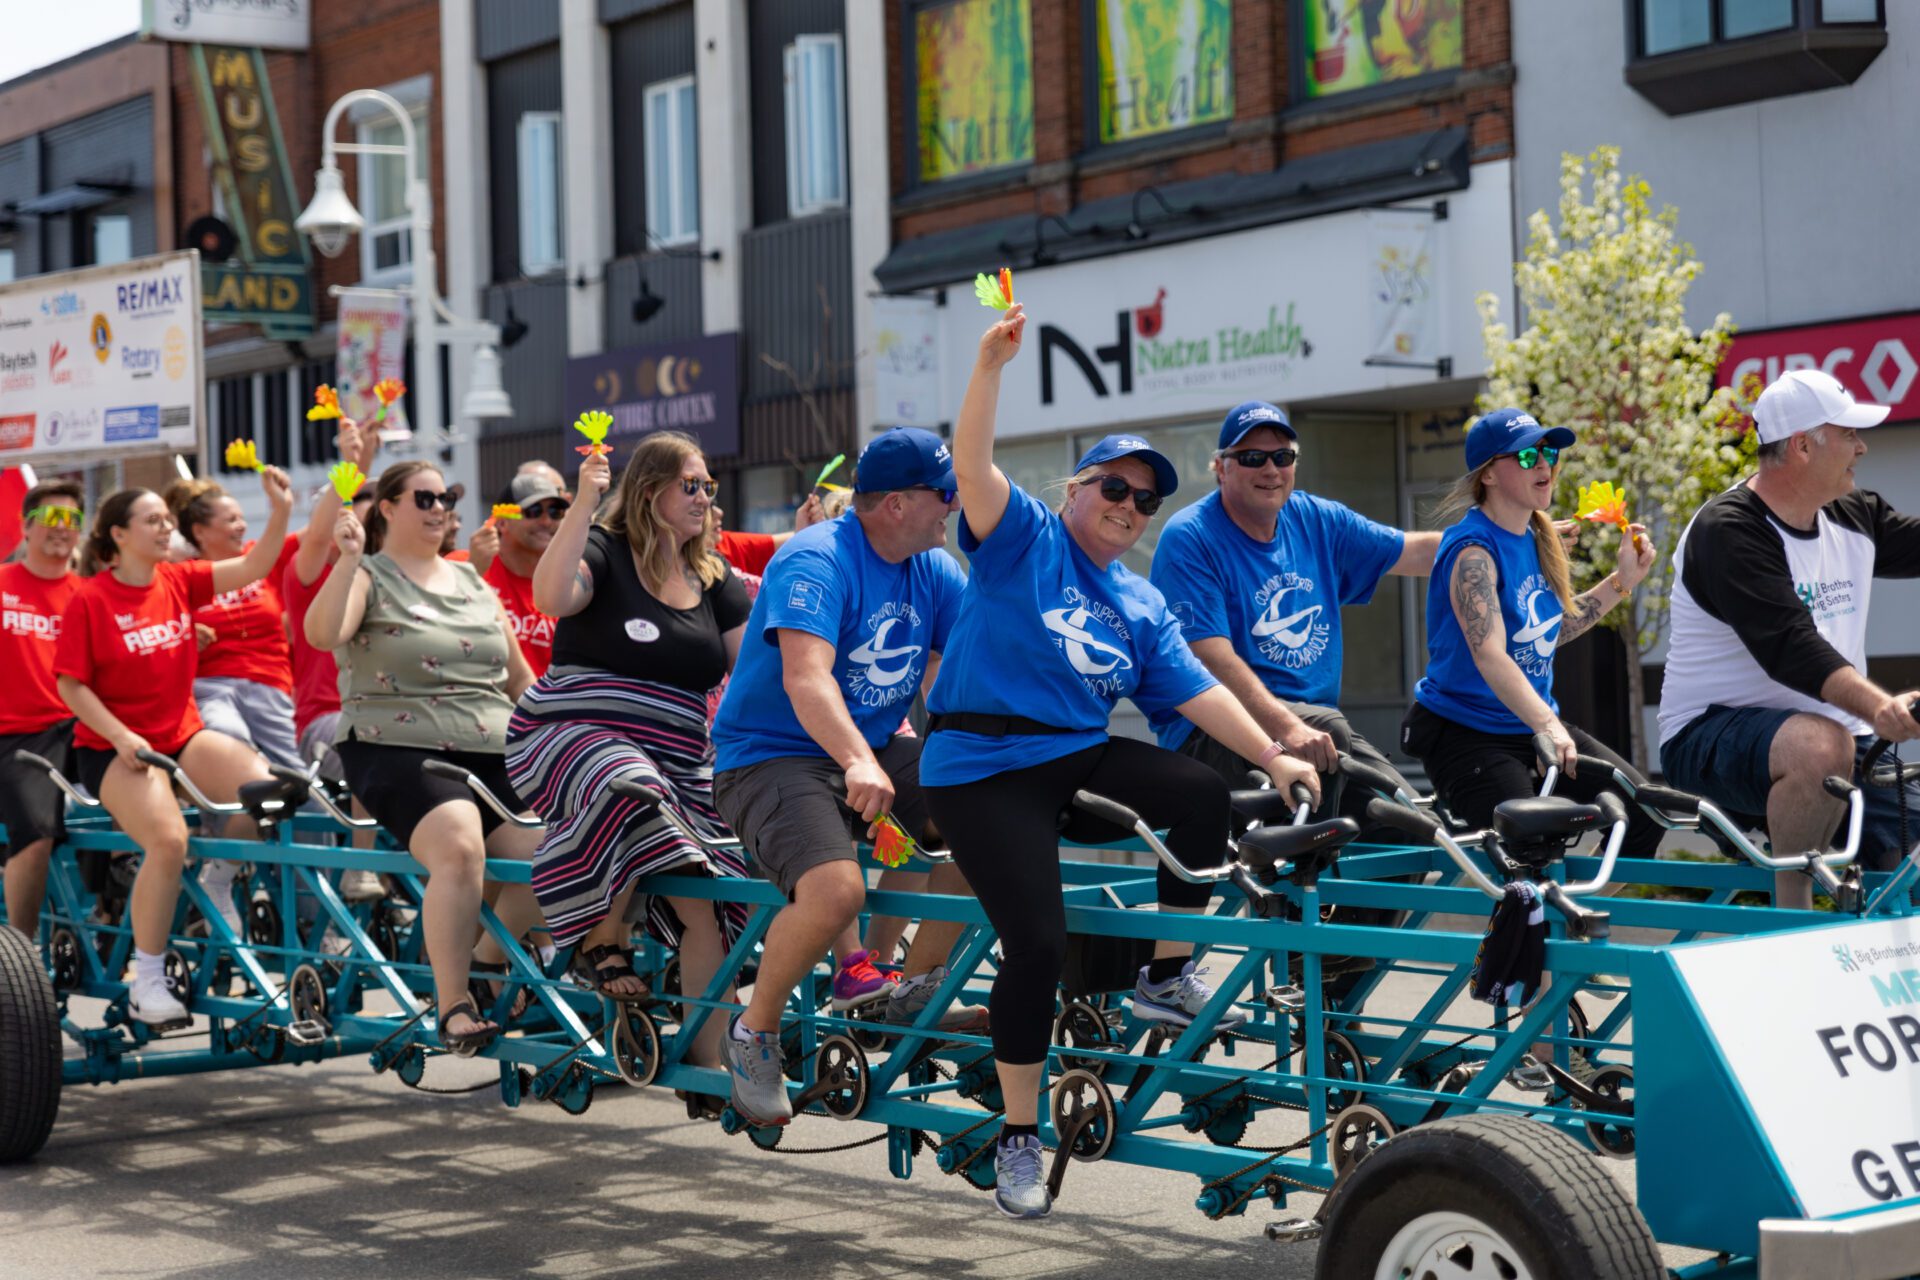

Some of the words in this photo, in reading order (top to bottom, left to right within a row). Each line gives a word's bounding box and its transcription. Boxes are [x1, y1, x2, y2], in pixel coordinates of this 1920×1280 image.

[212, 50, 289, 257] MUSIC
[117, 276, 182, 312] RE/MAX
[1137, 337, 1210, 375] Nutra
[1217, 303, 1302, 362] Health
[122, 346, 161, 372] Rotary
[1257, 636, 1285, 664] TEAM
[1854, 949, 1874, 965] Big
[1872, 945, 1909, 961] Brothers
